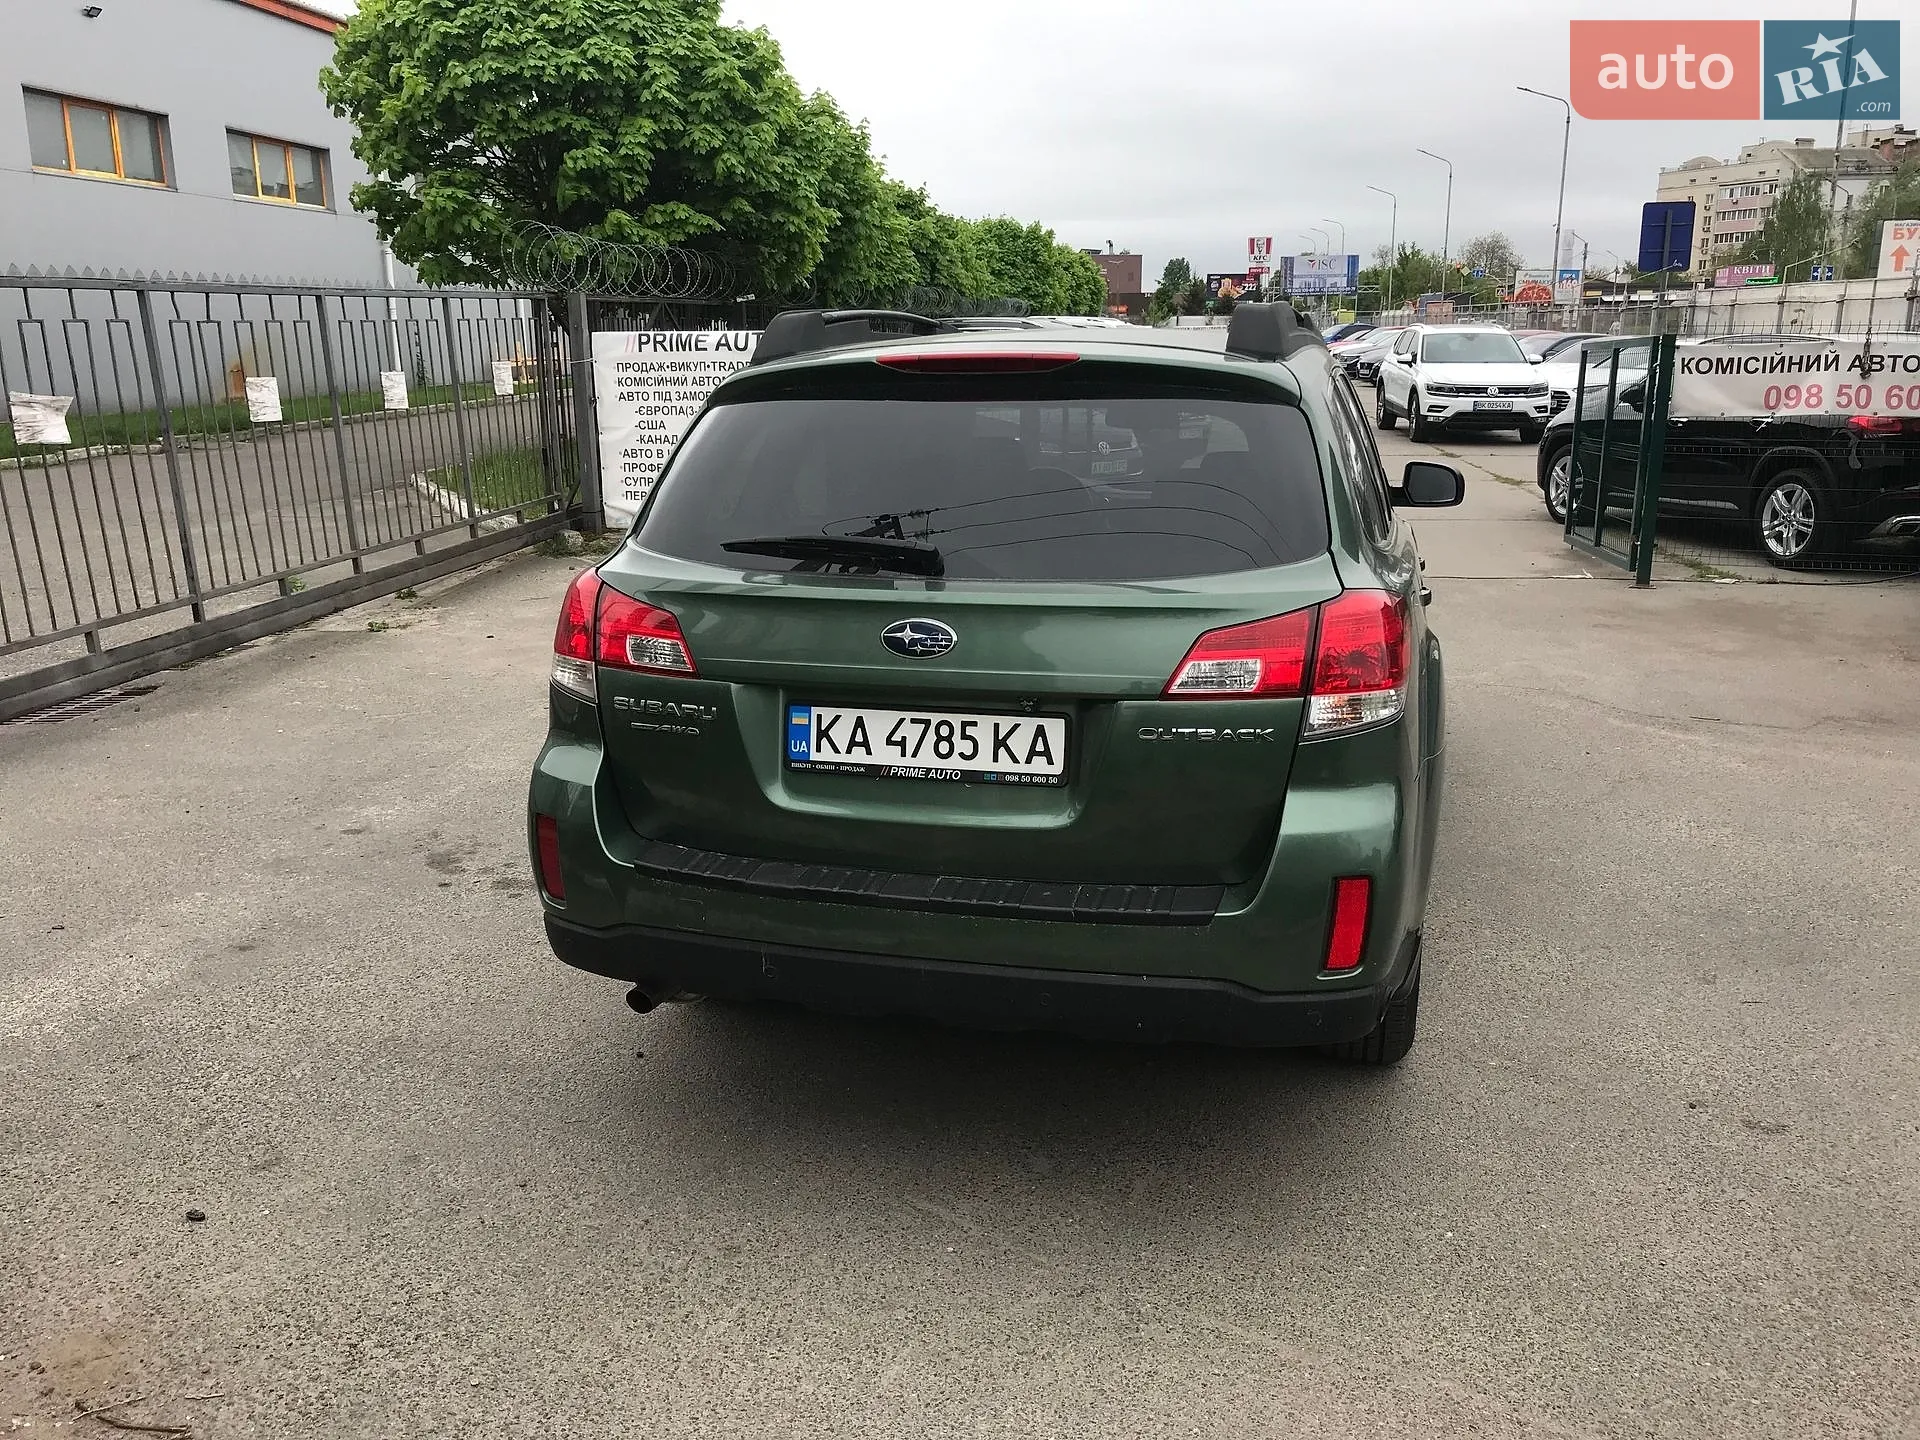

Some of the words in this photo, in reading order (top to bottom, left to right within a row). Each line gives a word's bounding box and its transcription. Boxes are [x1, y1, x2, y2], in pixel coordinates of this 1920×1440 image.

[1734, 265, 1770, 274] КВІТИ
[1680, 350, 1841, 374] КОМІСІЙНИЙ
[617, 374, 688, 387] КОМІСІЙНИЙ
[618, 392, 650, 402] АВТО
[653, 391, 672, 403] ПІД
[1763, 384, 1823, 411] 098
[1835, 384, 1873, 410] 50
[623, 448, 653, 459] АВТО
[656, 448, 664, 459] В
[624, 476, 654, 487] СУПР
[613, 696, 717, 720] SUBARU
[815, 713, 873, 756] KA
[885, 717, 980, 761] 4785
[992, 722, 1055, 766] KA
[1137, 728, 1275, 743] OUTBACK
[791, 740, 808, 753] UA
[928, 769, 961, 780] AUTO
[1021, 775, 1031, 783] 50
